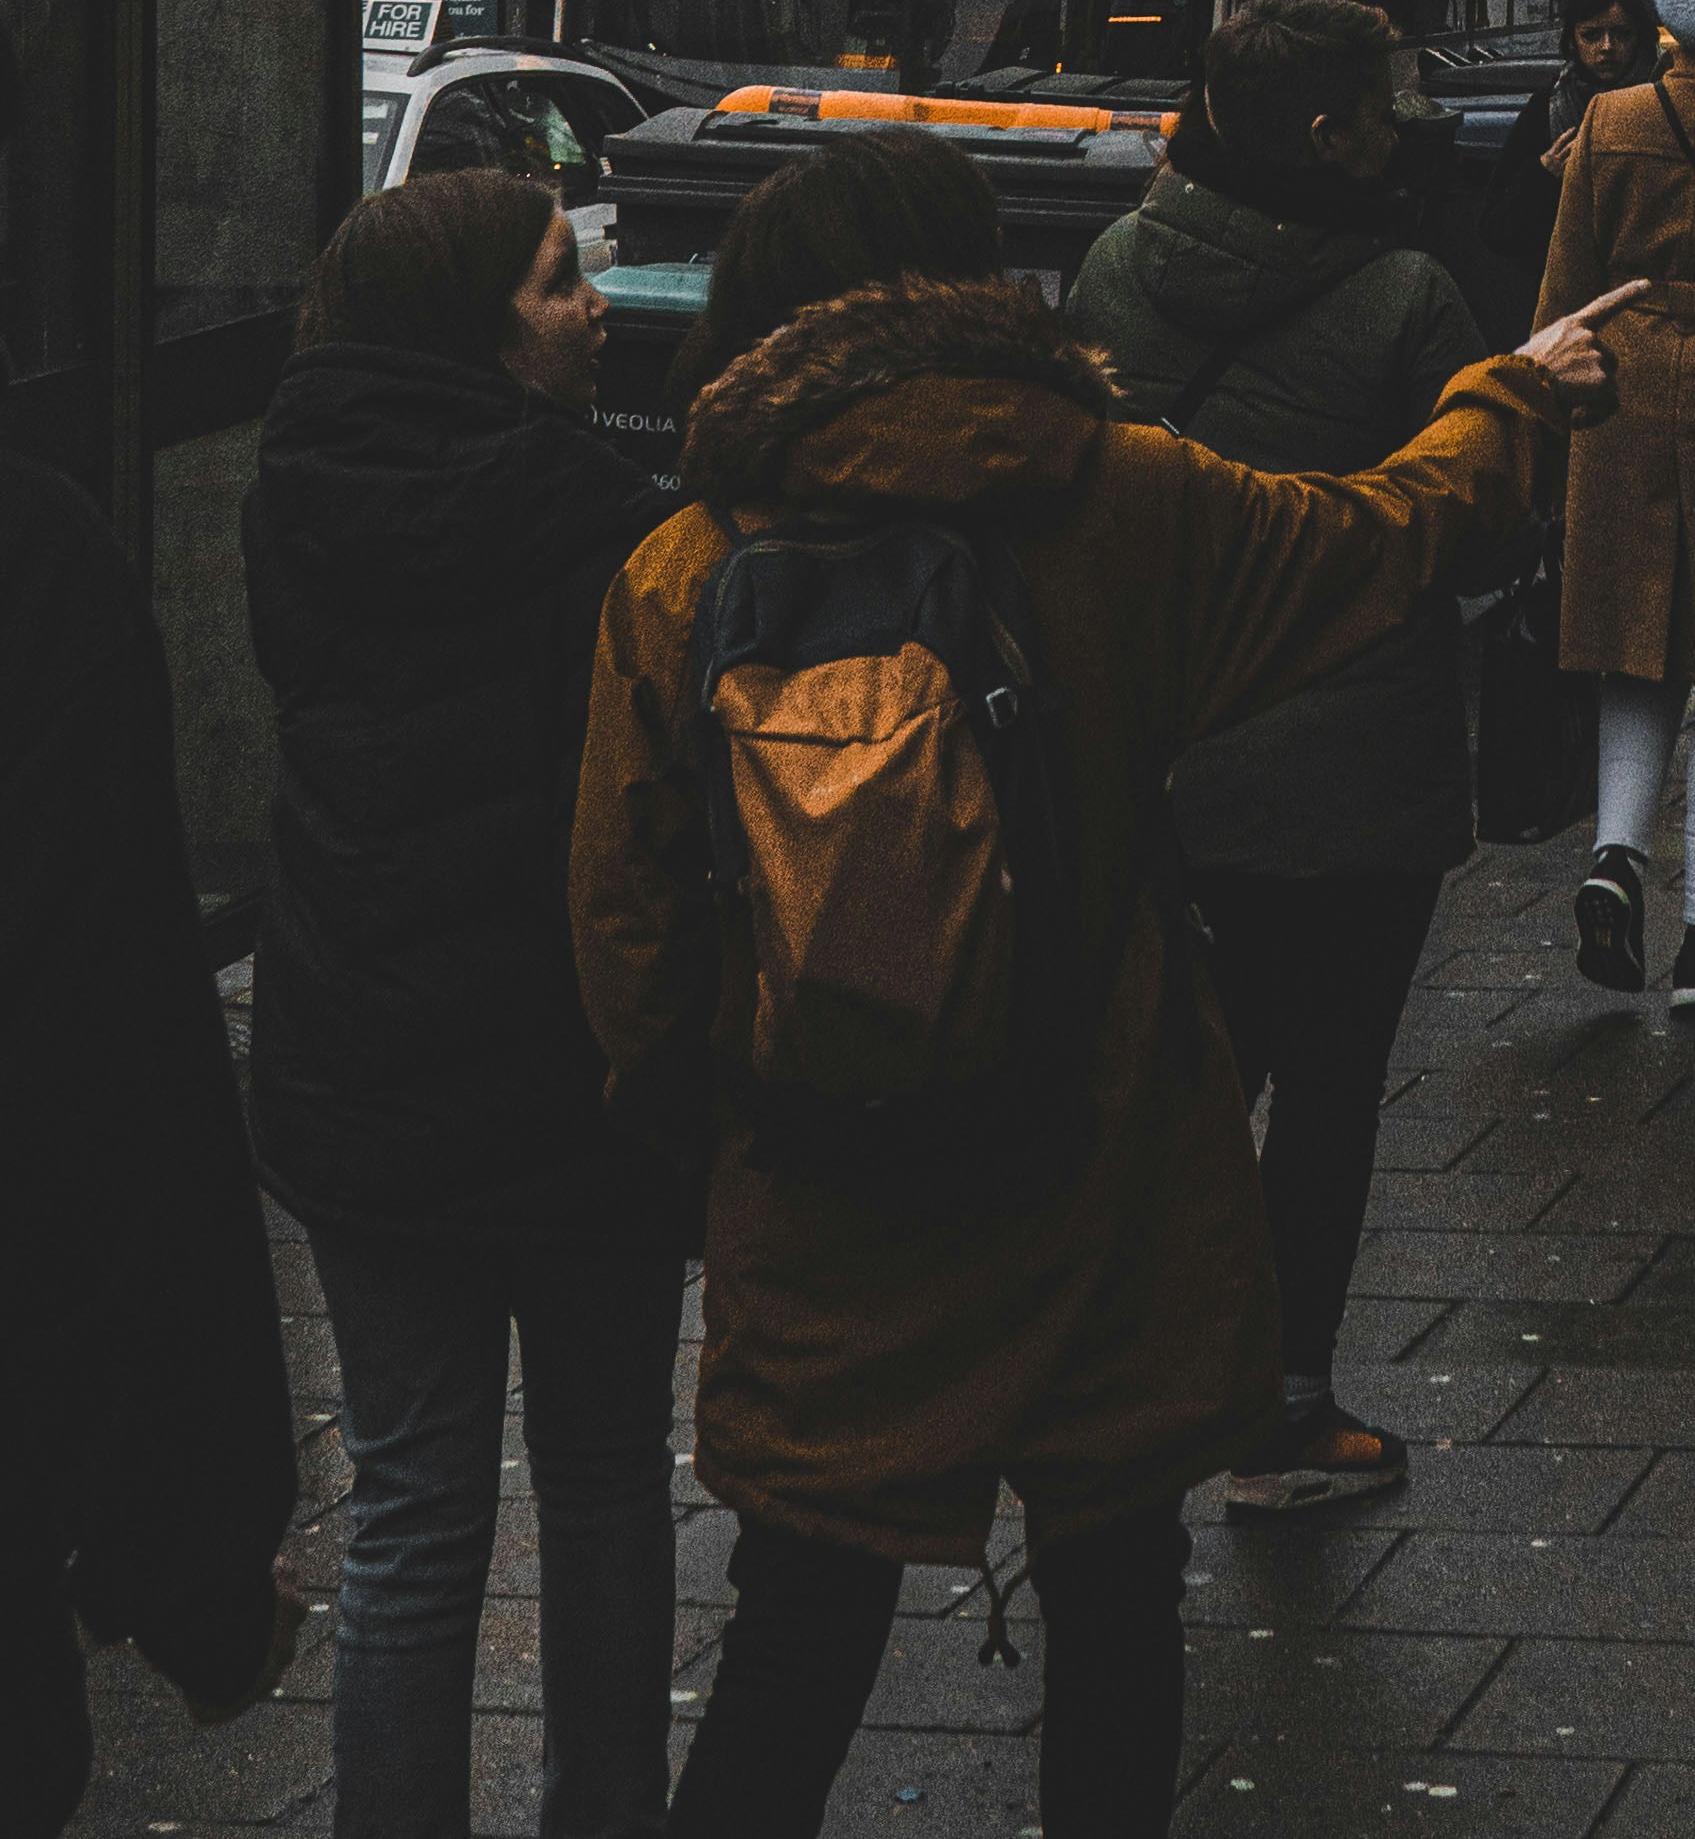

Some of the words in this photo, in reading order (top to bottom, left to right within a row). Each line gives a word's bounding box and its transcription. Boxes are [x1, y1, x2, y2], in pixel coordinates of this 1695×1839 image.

[377, 4, 422, 20] FOR
[447, 6, 464, 16] ou
[465, 4, 485, 16] for
[369, 21, 422, 38] HIRE
[602, 412, 677, 433] VEOLIA
